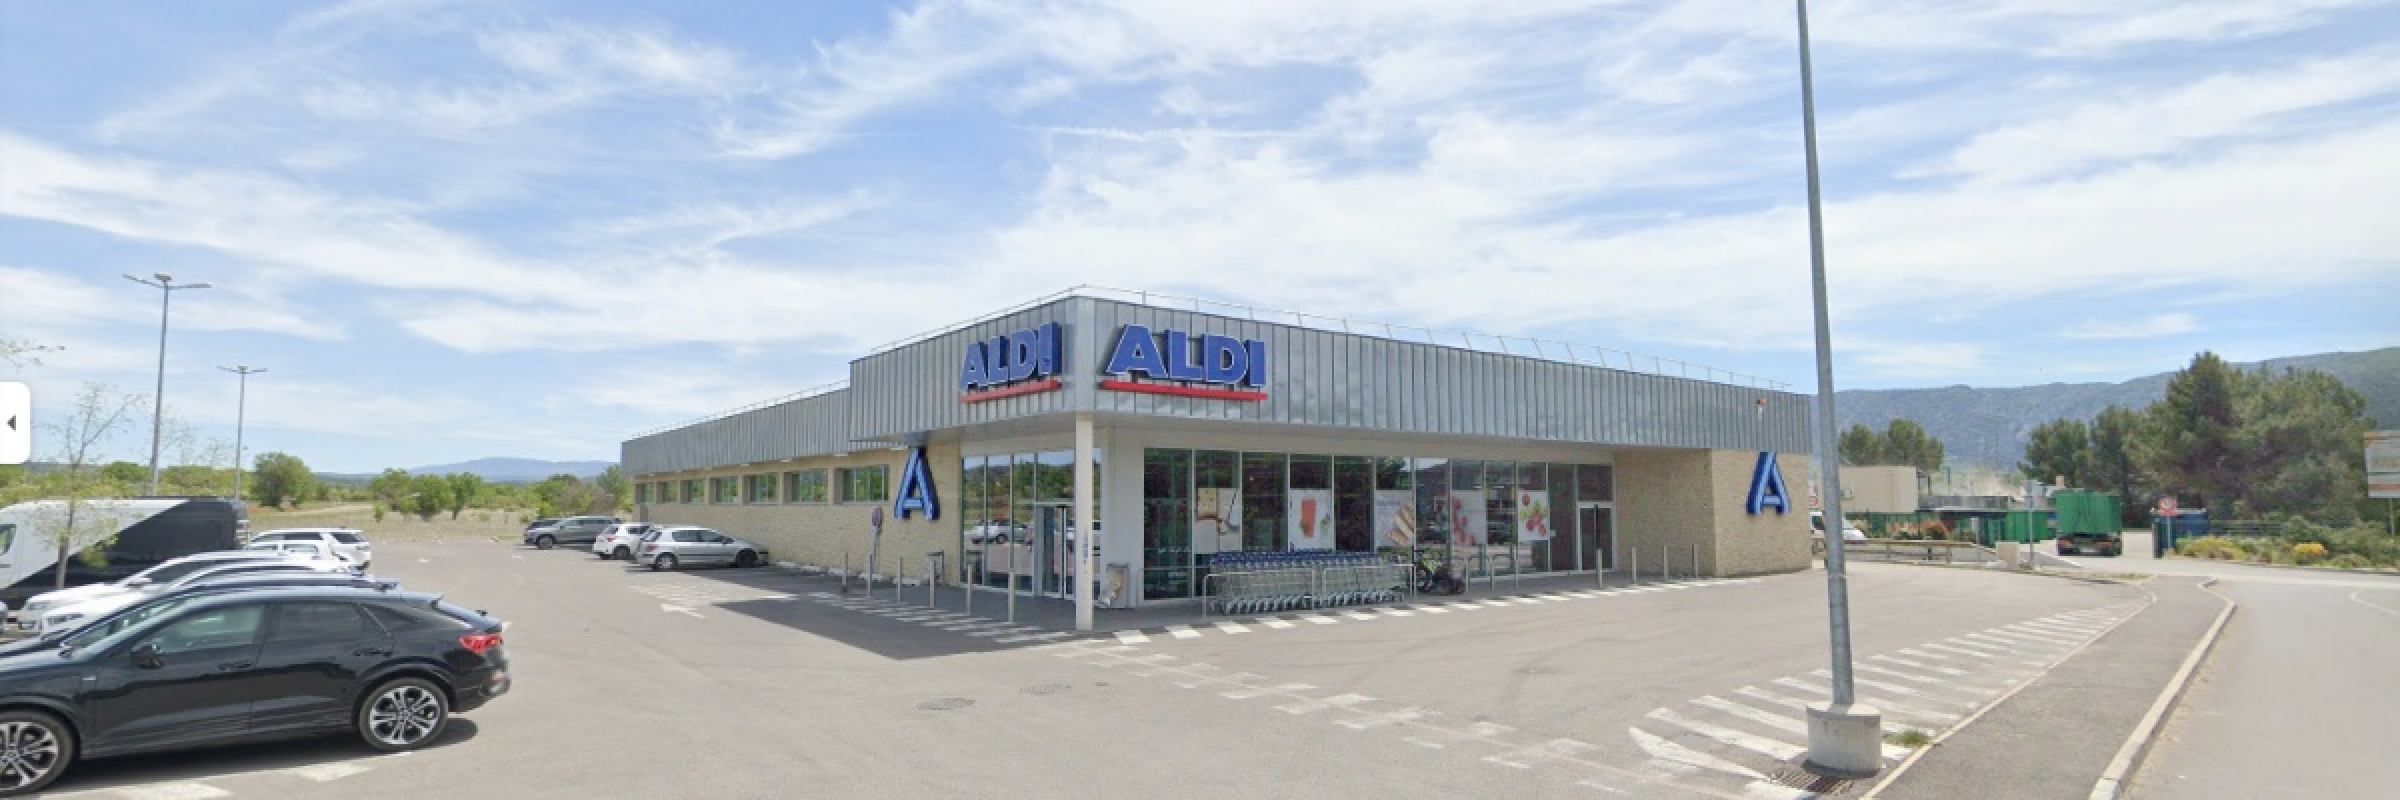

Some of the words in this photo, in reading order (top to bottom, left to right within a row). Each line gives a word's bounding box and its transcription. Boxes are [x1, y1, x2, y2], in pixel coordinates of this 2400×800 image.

[959, 323, 1061, 390] ALDI
[1106, 324, 1266, 386] ALDI
[894, 447, 940, 520] A
[1745, 452, 1791, 516] A
